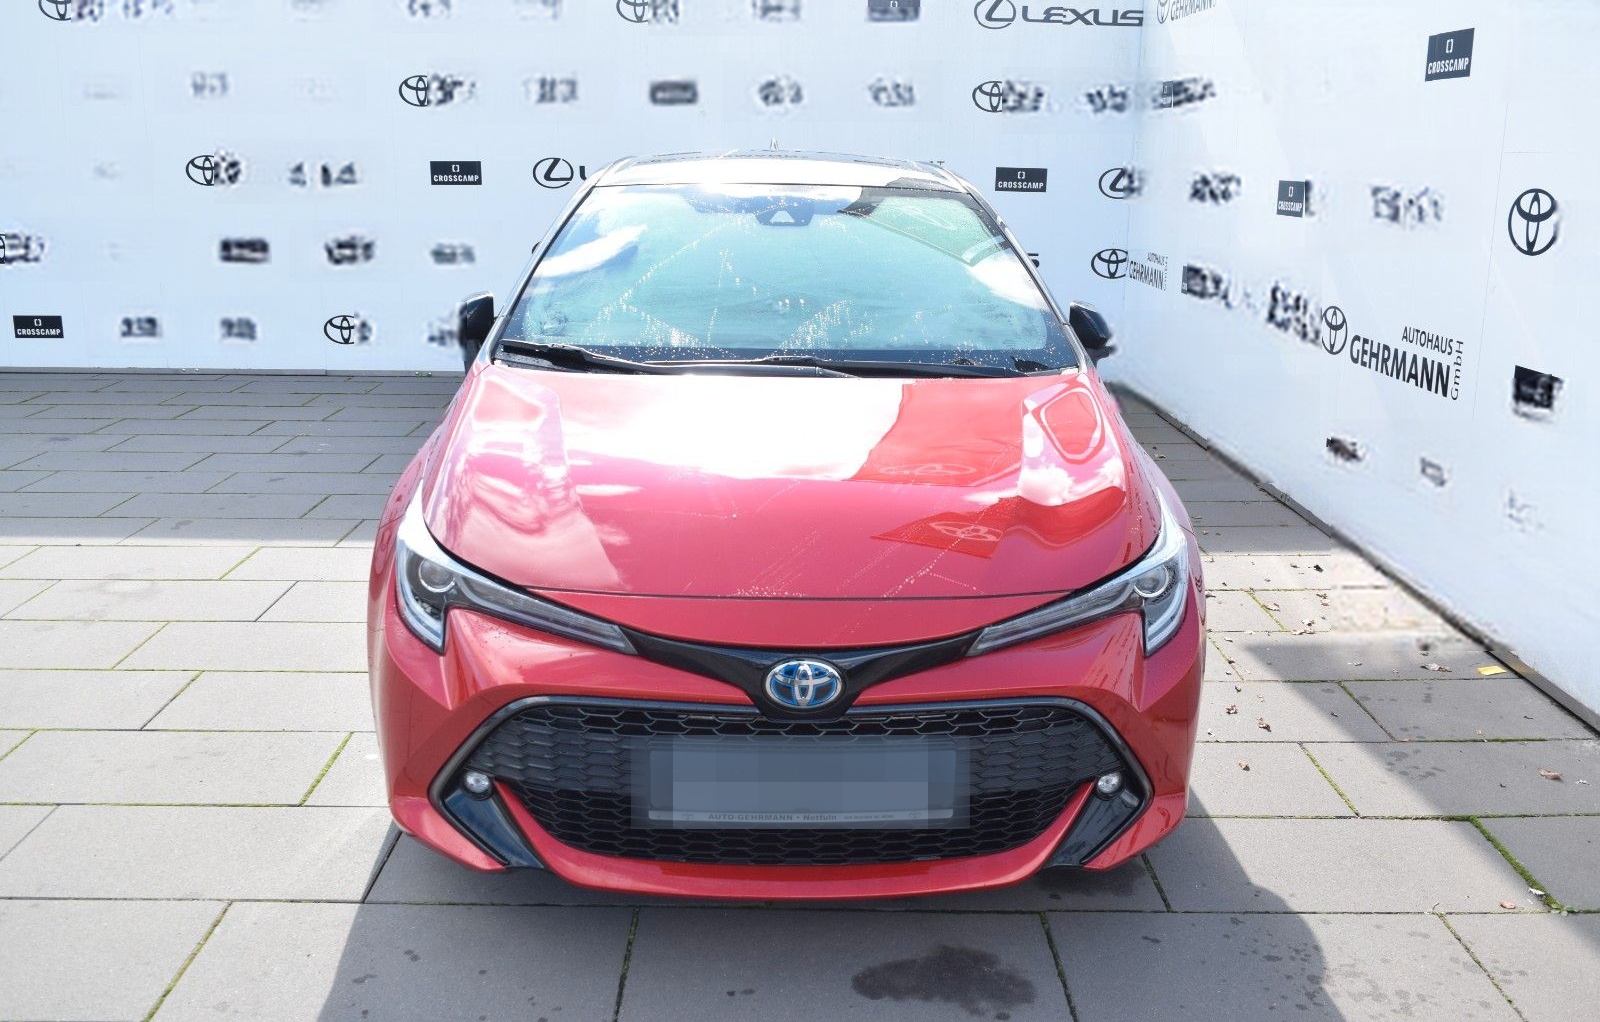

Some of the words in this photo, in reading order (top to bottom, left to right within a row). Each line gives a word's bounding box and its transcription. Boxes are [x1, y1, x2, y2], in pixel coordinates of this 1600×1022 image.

[1022, 5, 1143, 26] LEXUS
[1427, 57, 1469, 74] CROSSCAMP
[433, 174, 479, 182] CROSSCAMP
[998, 181, 1044, 189] CROSSCAMP
[1128, 260, 1164, 290] GEHRMANN
[1401, 326, 1453, 356] AUTOHAUS
[1350, 334, 1451, 398] GEHRMANN
[1450, 340, 1464, 400] GmbH
[708, 813, 793, 821] AUTO-GEHRMANN
